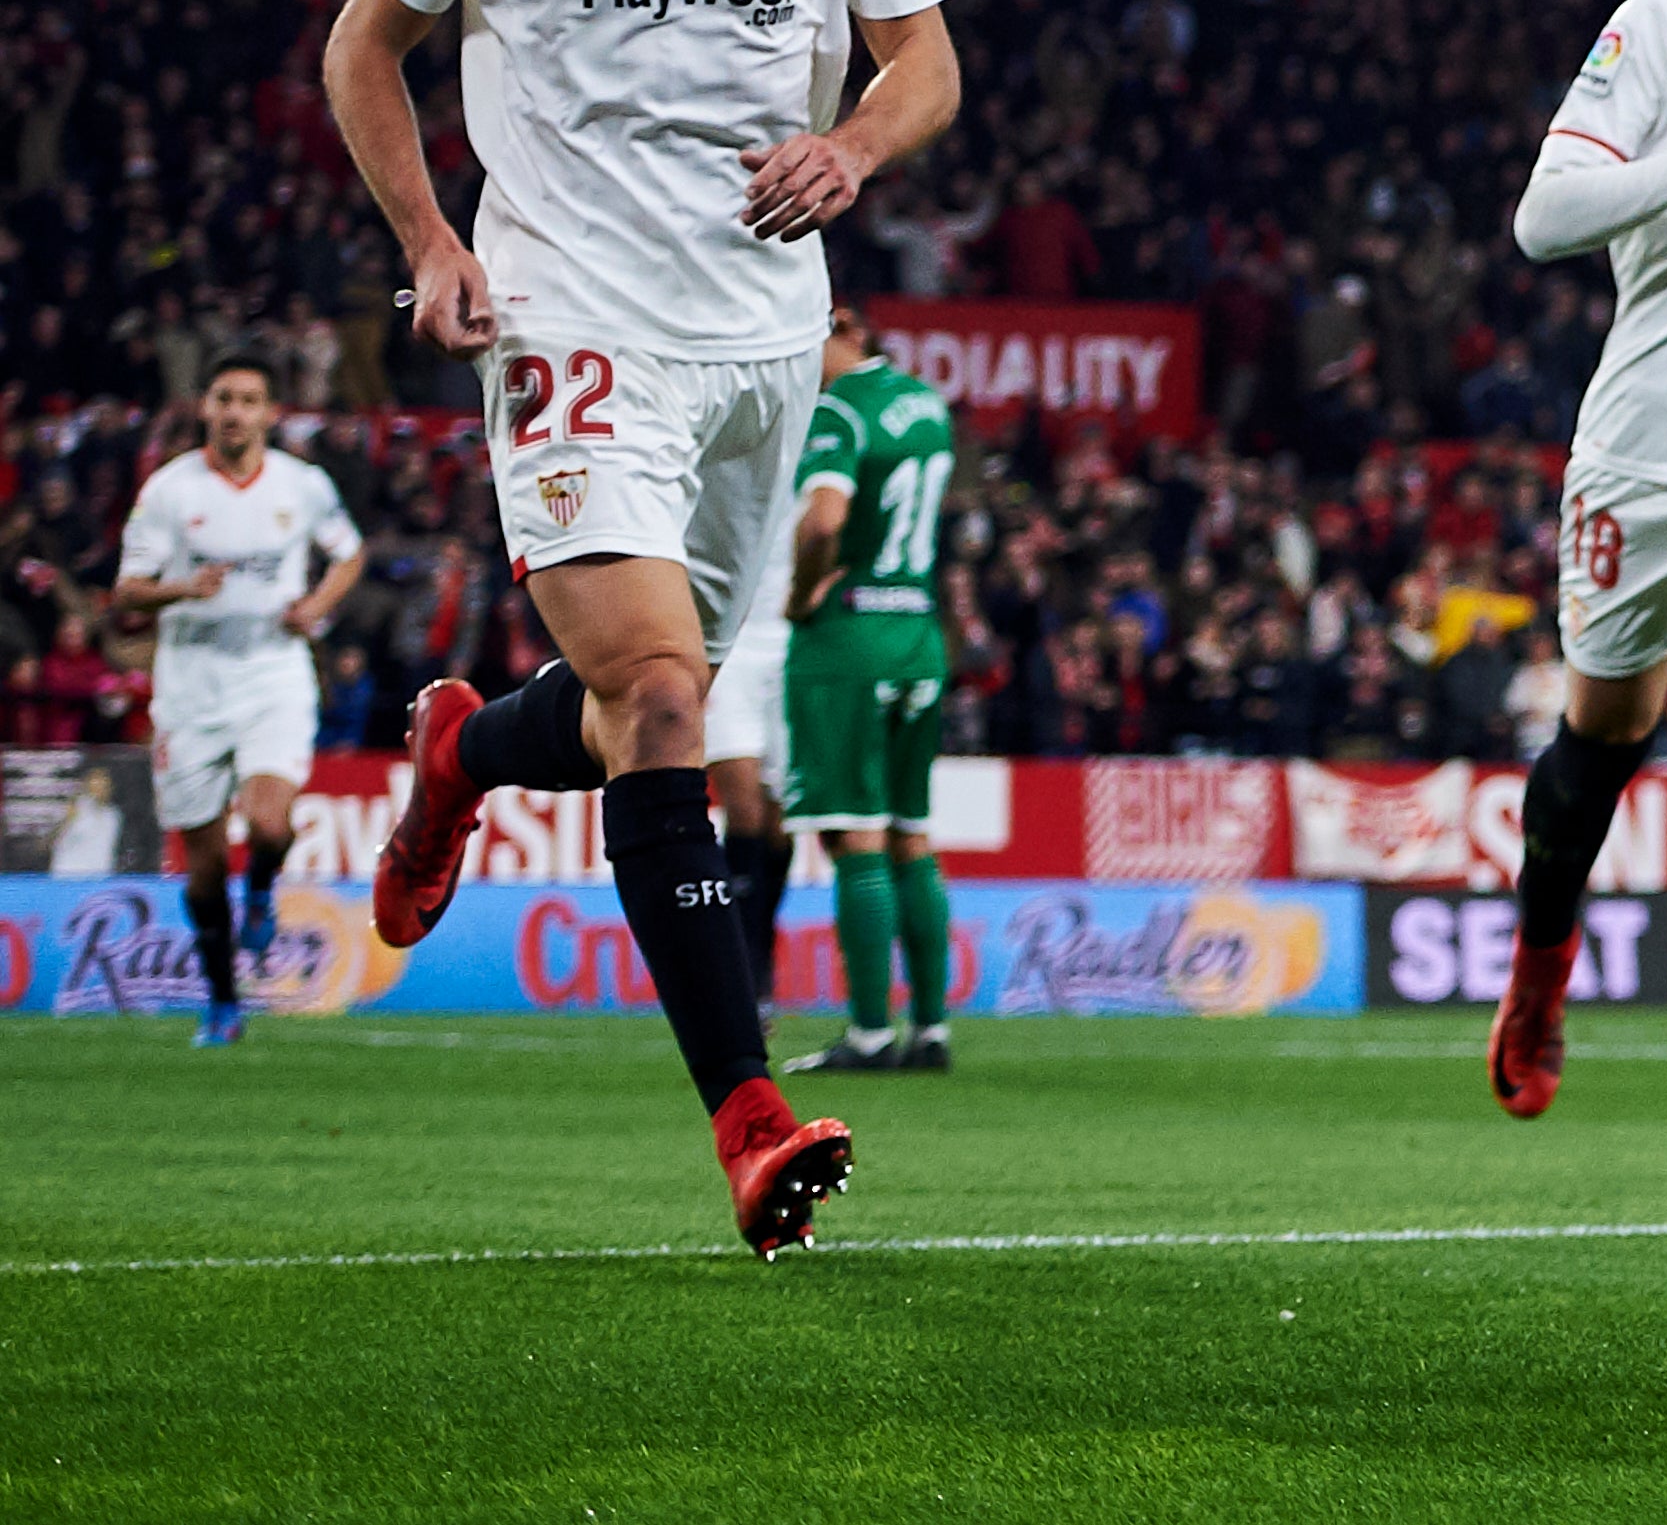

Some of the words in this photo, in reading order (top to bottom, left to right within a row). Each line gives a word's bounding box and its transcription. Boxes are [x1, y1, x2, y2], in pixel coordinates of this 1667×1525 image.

[505, 349, 614, 453] 22
[1570, 494, 1624, 590] 18
[675, 880, 732, 908] SFC
